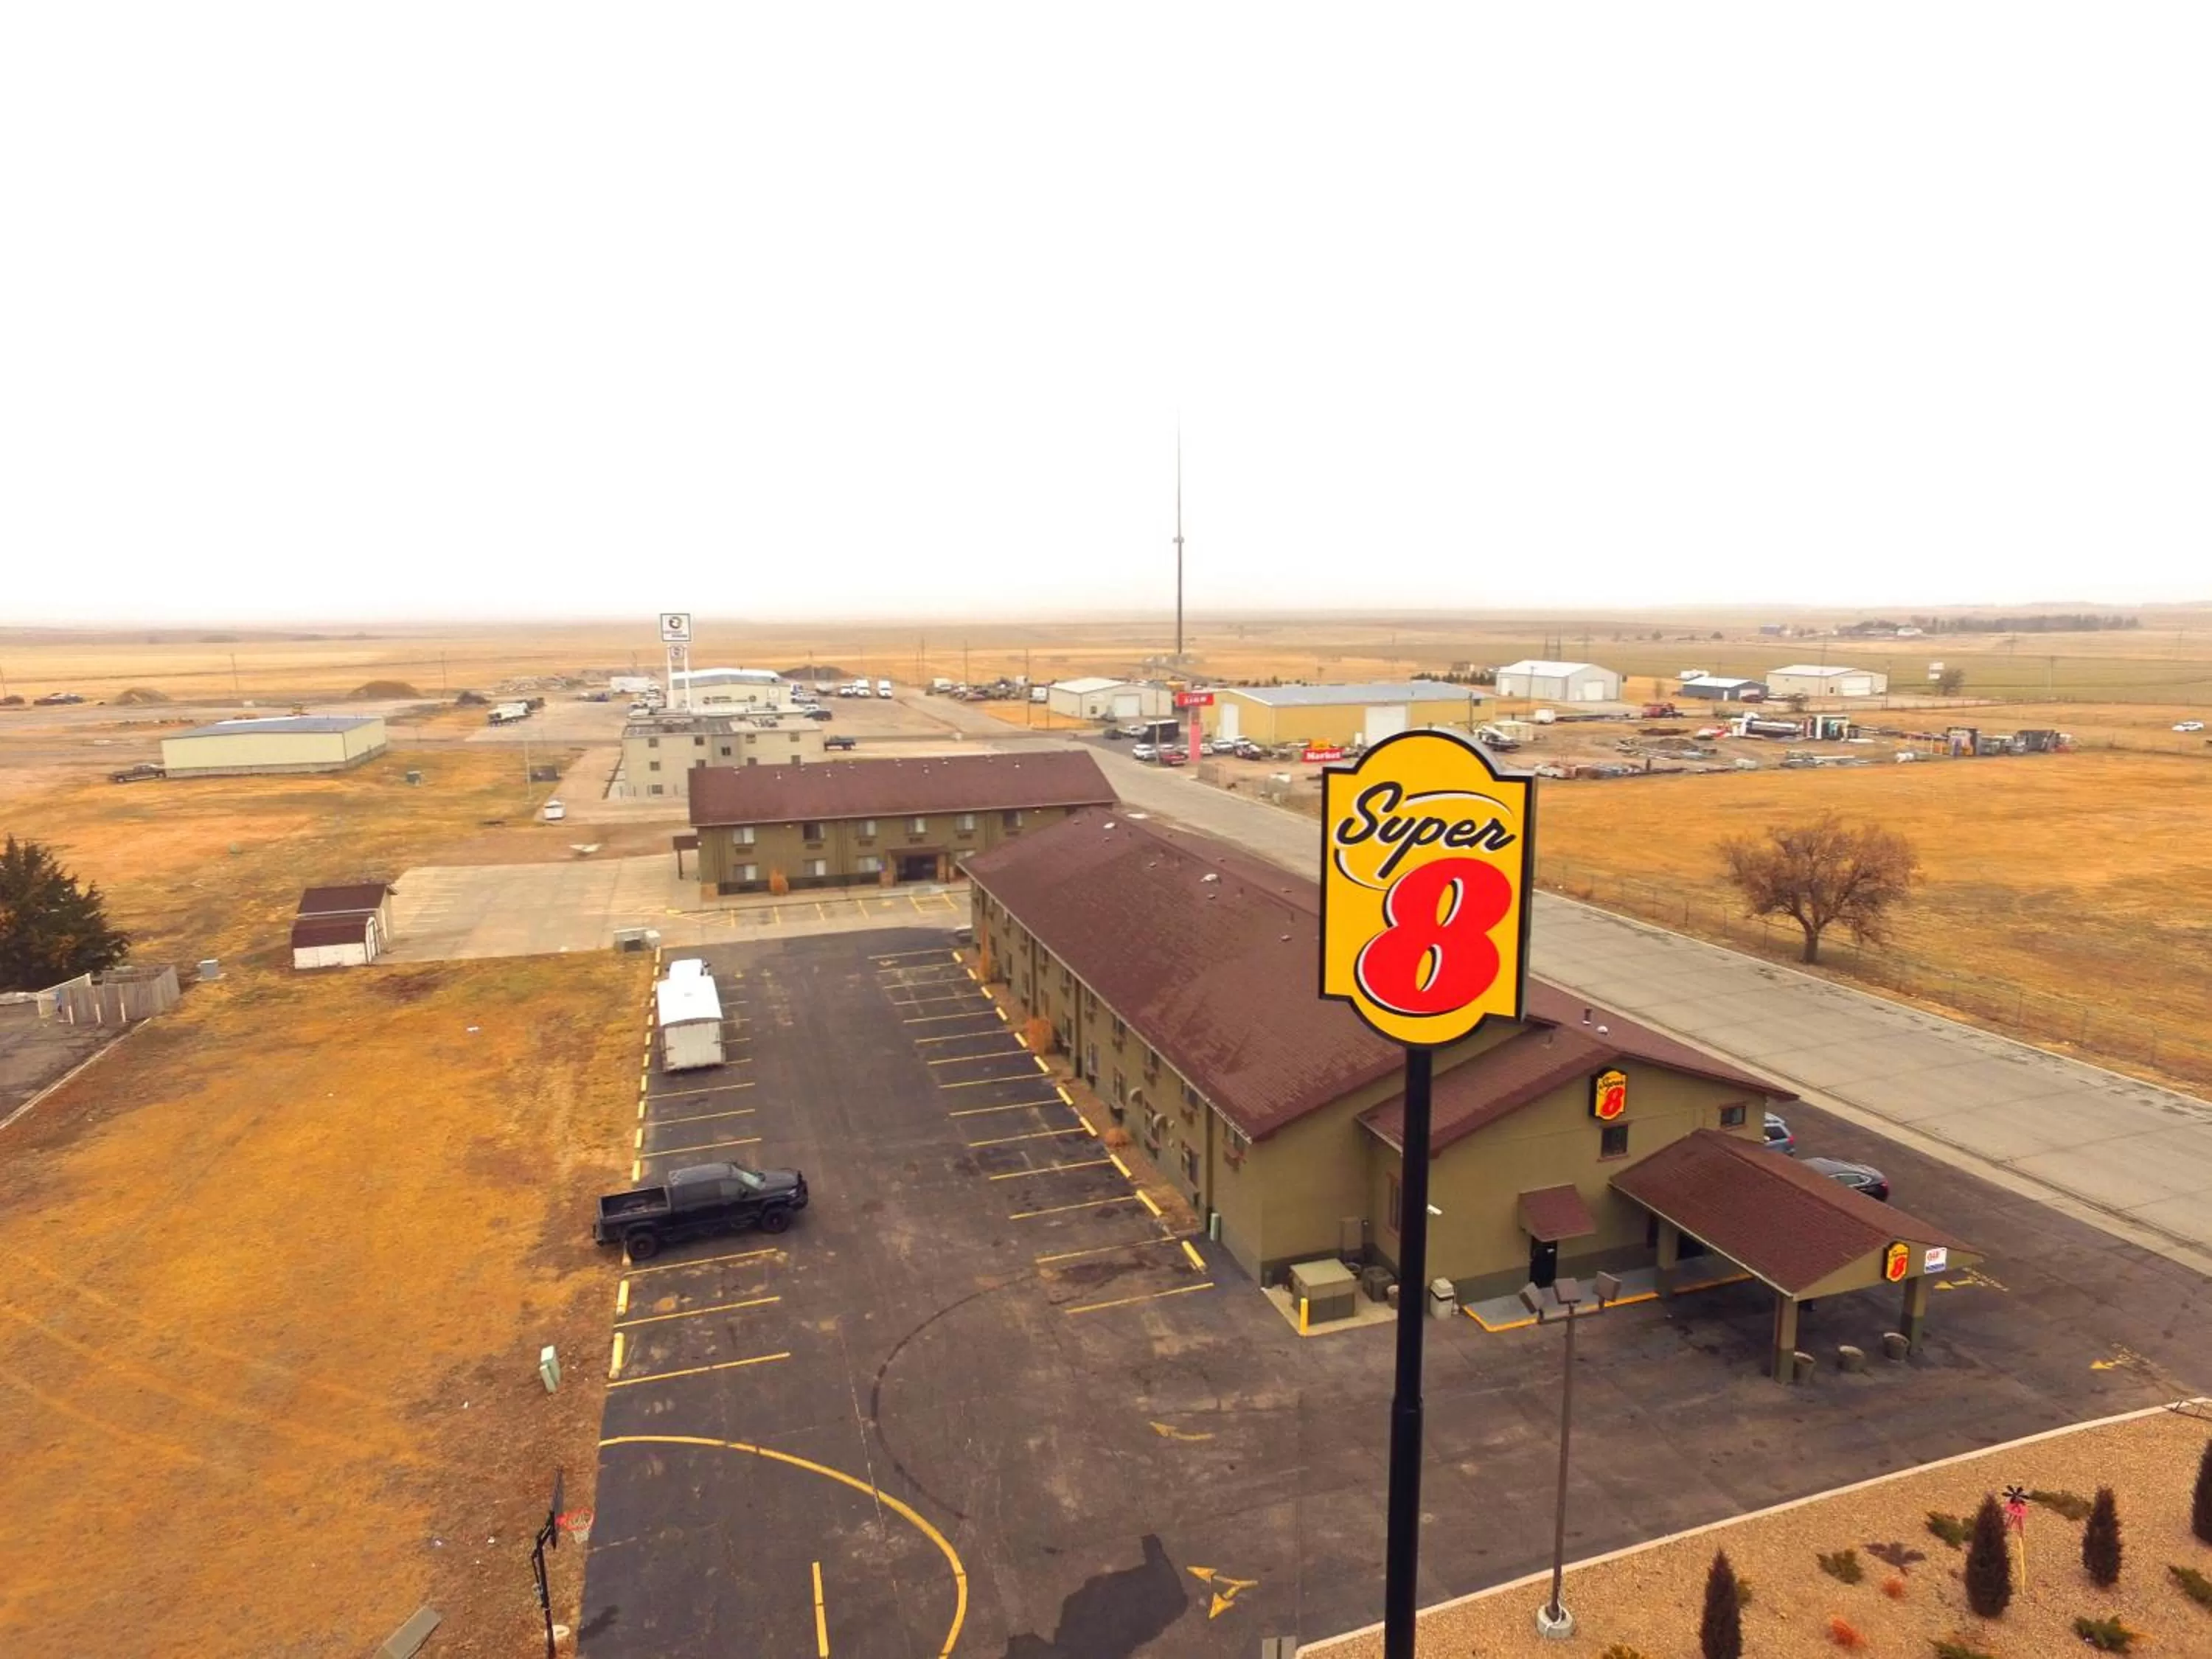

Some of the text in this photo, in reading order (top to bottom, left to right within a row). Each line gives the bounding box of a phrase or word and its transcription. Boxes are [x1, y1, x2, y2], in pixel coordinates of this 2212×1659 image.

[1335, 780, 1517, 880] Super
[1354, 856, 1513, 1018] 8
[1601, 1085, 1625, 1117] 8
[1891, 1256, 1907, 1279] 8
